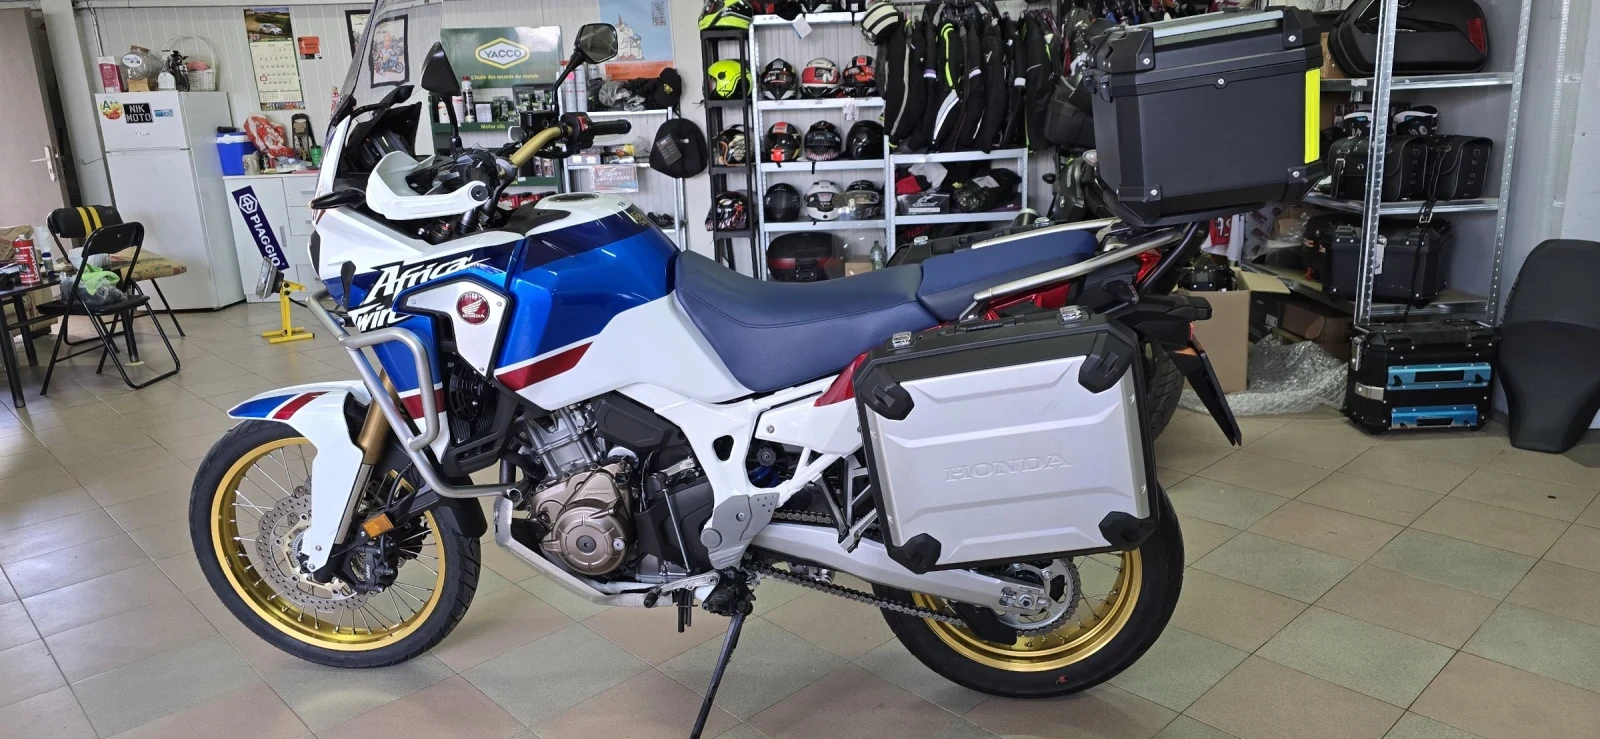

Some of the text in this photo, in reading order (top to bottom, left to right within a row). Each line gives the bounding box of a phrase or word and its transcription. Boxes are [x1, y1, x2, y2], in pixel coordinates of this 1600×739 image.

[484, 49, 522, 59] YACCO
[126, 113, 152, 122] MOTO
[129, 104, 145, 113] NIK
[250, 213, 281, 267] PIAGGIO
[360, 253, 478, 306] Africa
[347, 303, 411, 331] Twin
[944, 454, 1072, 482] HONDA
